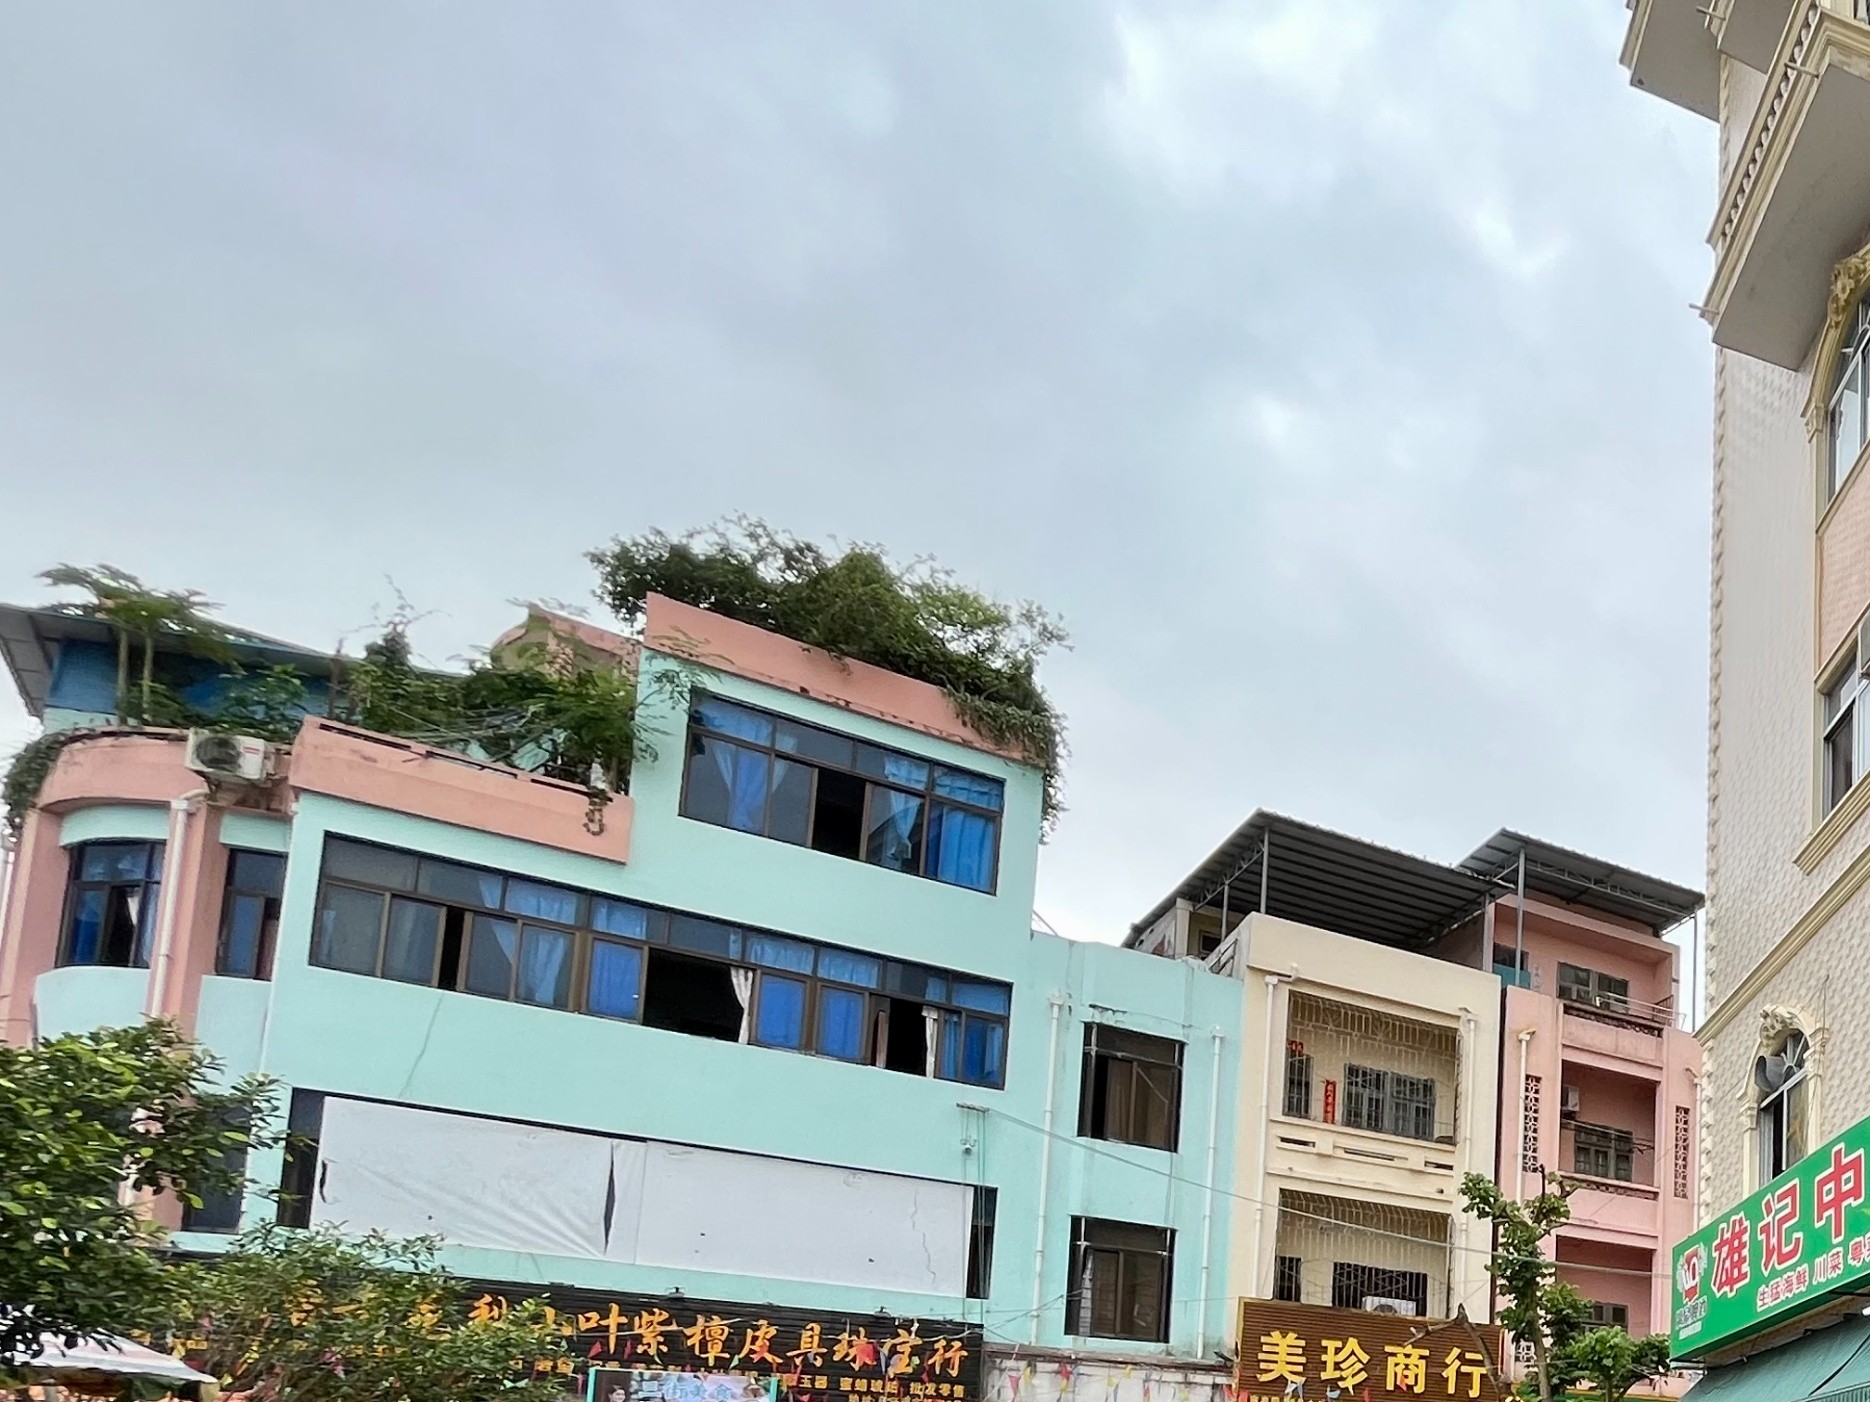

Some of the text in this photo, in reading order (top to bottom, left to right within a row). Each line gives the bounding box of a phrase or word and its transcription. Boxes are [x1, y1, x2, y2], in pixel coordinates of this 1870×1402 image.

[1757, 1265, 1808, 1310] 生猛海鲜
[1814, 1251, 1843, 1281] 川菜
[1257, 1330, 1487, 1398] 美珍商行
